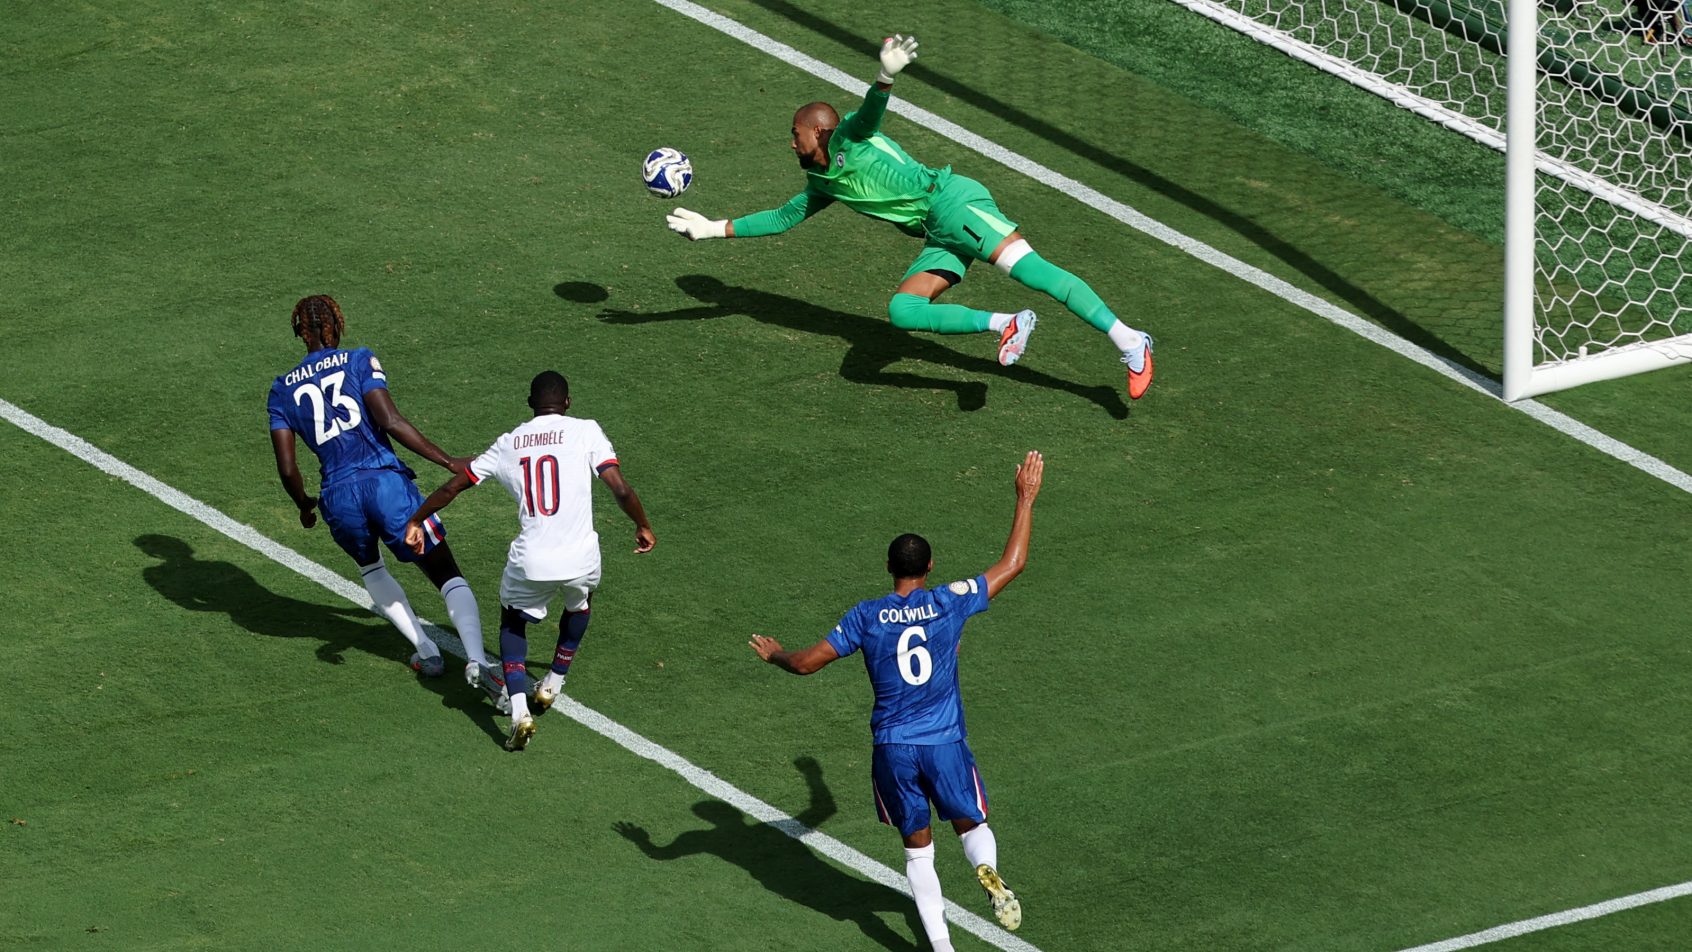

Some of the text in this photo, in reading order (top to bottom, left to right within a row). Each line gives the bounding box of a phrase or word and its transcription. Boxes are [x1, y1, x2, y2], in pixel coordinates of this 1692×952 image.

[962, 224, 982, 243] 1
[285, 352, 348, 386] CHALOBAH
[293, 370, 361, 446] 23
[519, 454, 560, 517] 10
[879, 604, 938, 624] COLWILL
[896, 625, 933, 686] 6
